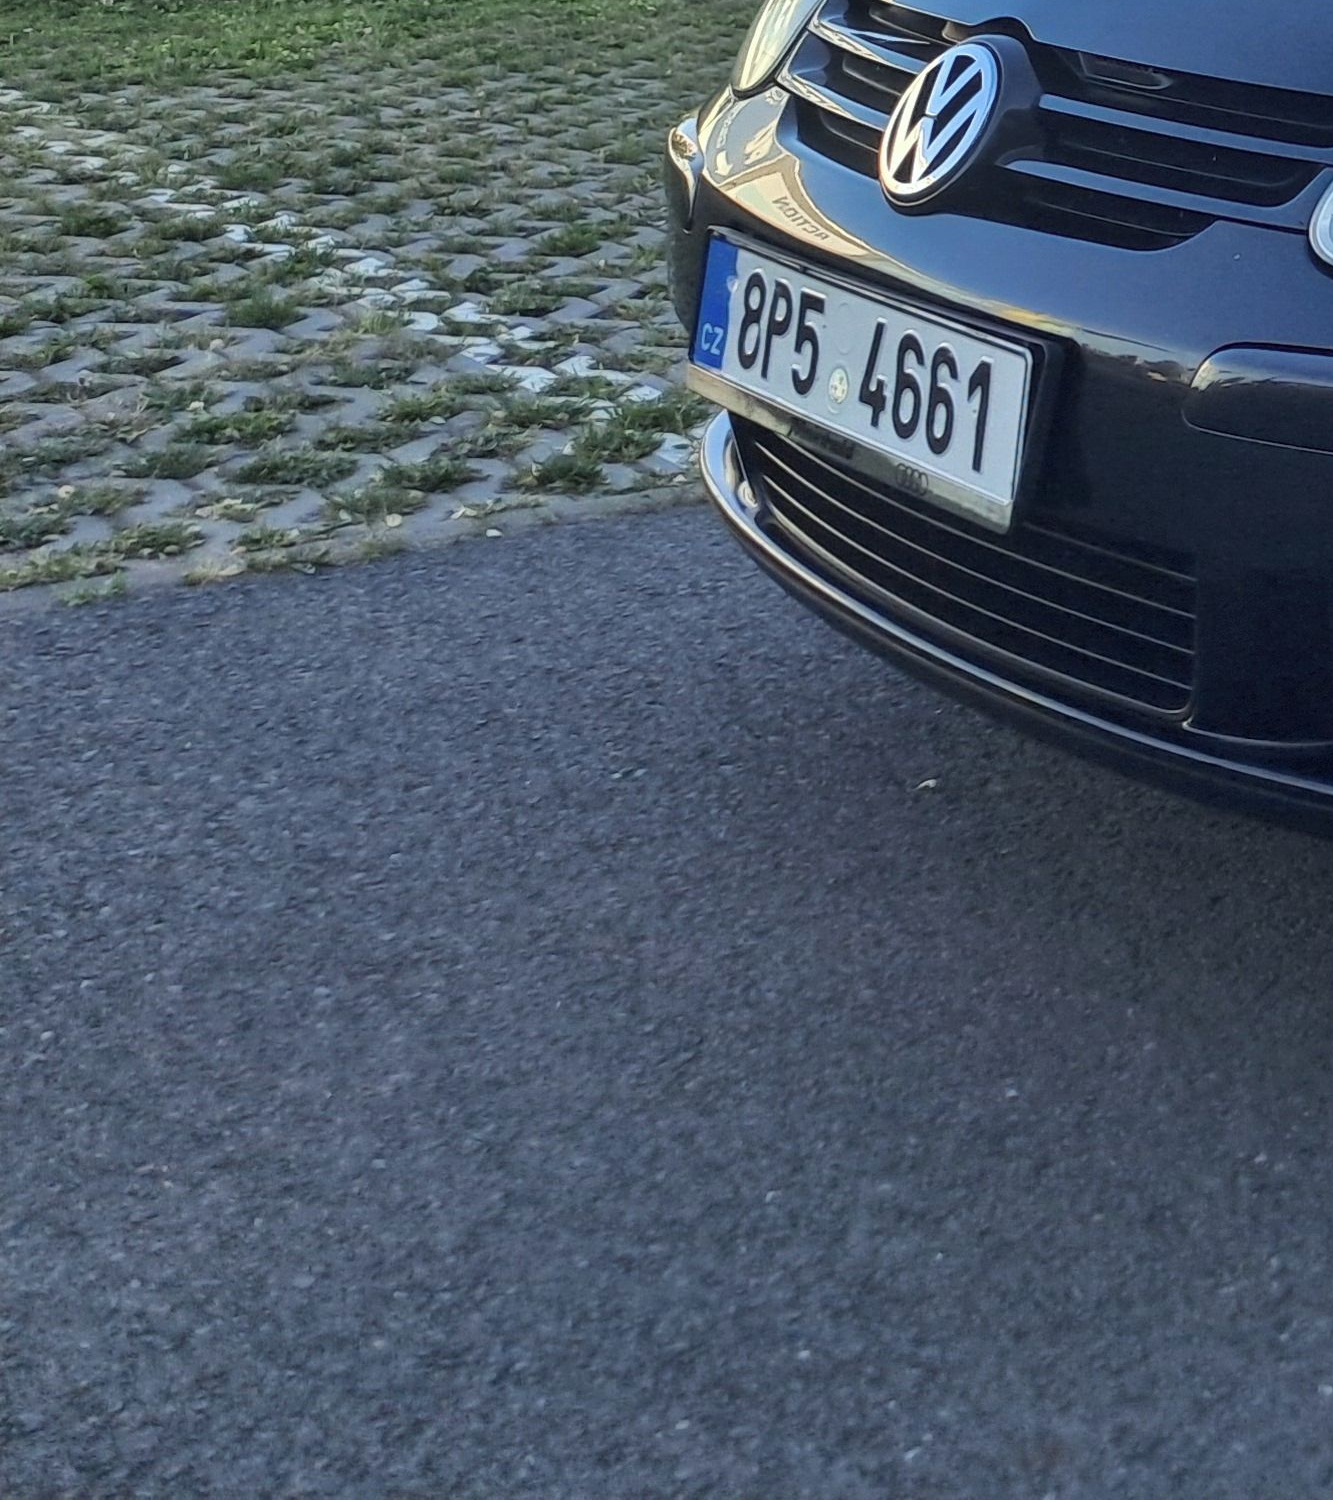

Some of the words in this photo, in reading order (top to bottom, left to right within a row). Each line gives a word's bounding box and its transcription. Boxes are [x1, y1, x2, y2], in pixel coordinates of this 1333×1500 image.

[699, 322, 724, 356] CZ
[737, 268, 827, 396] 8P5
[859, 316, 994, 473] 4661
